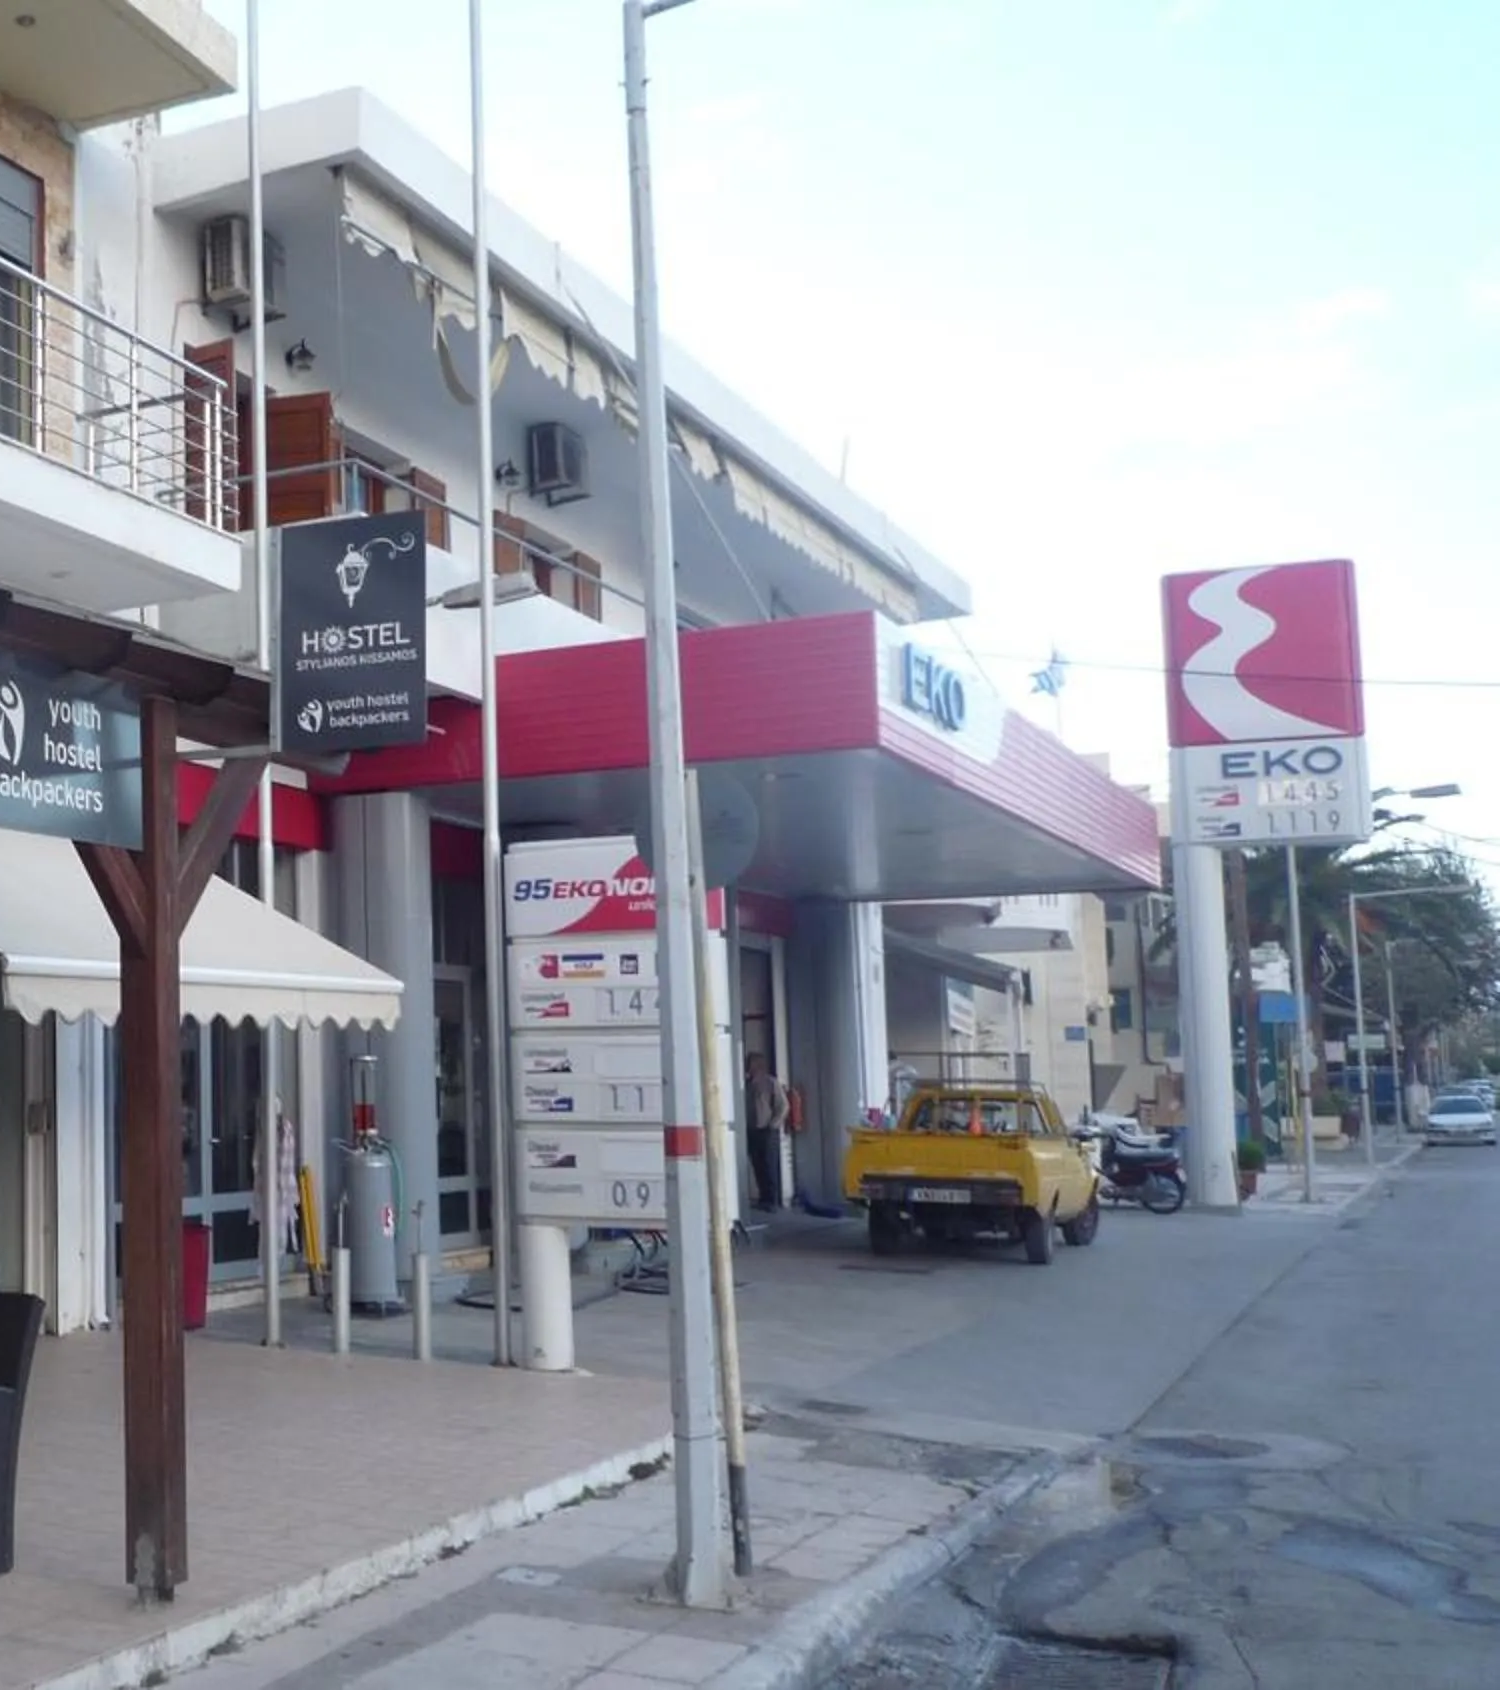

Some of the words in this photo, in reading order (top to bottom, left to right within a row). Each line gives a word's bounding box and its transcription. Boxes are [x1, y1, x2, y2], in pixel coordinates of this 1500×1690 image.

[302, 621, 411, 655] HOSTEL
[296, 654, 358, 671] STYLIANOS
[360, 647, 418, 665] KISSAMOS
[326, 695, 365, 712] youth
[367, 691, 409, 706] hostel
[902, 641, 966, 731] EKO
[49, 698, 102, 732] youth
[328, 709, 410, 728] backpackers
[43, 731, 103, 773] hostel
[1221, 745, 1343, 779] EKO
